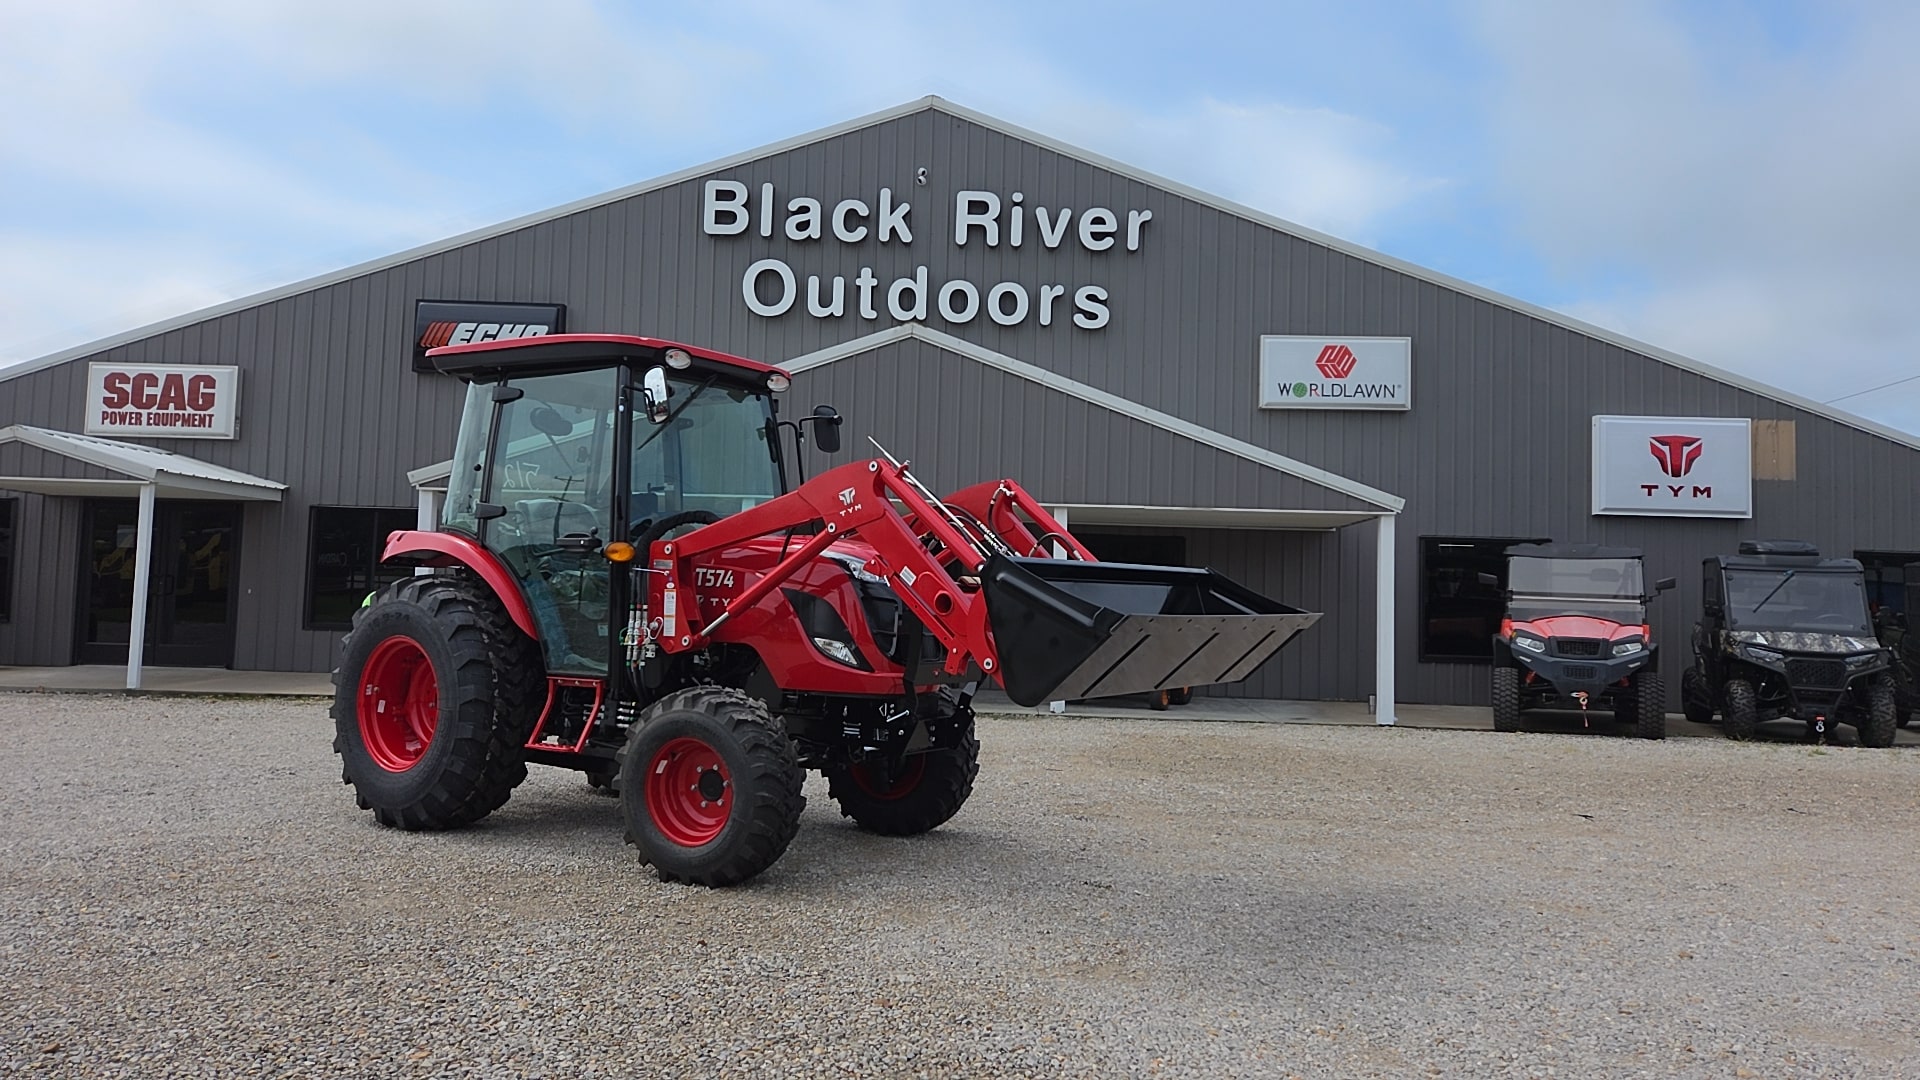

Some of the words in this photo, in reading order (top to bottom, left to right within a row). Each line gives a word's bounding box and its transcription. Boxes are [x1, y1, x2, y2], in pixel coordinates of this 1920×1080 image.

[703, 179, 913, 244] Black
[955, 189, 1154, 252] River
[742, 257, 1111, 330] Outdoors
[102, 372, 217, 412] SCAG
[1277, 381, 1396, 399] WORLDLAWN
[101, 411, 143, 426] POWER
[146, 412, 215, 429] EQUIPMENT
[1640, 484, 1712, 499] TYM
[839, 503, 862, 517] TYM
[695, 567, 734, 588] T574
[710, 597, 737, 607] TY
